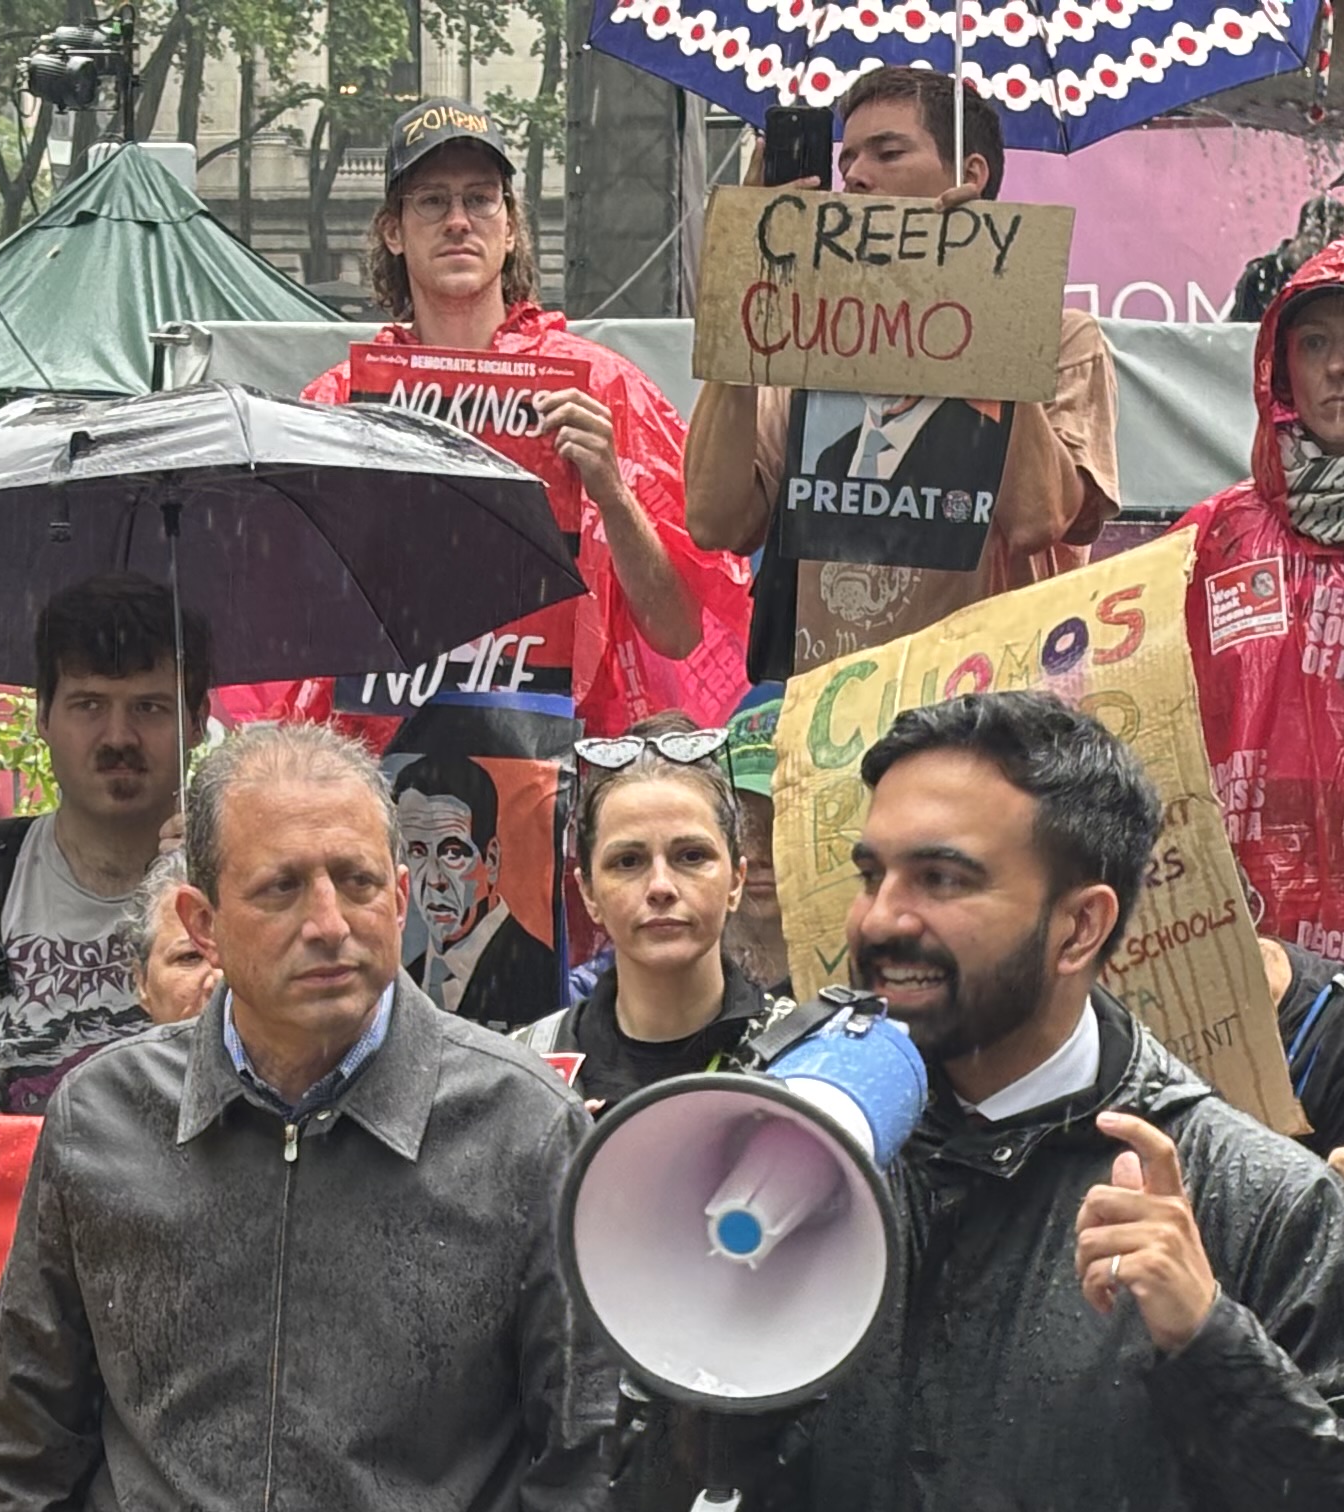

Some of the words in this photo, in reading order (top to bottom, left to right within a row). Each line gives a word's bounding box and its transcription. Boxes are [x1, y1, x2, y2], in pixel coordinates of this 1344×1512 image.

[757, 194, 1022, 276] CREEPY
[741, 281, 973, 361] CUOMO
[411, 354, 476, 373] DEMOCRATIC
[477, 359, 536, 377] SOCIALISTS
[447, 382, 552, 438] KINGS
[1127, 898, 1236, 967] SCHOOLS
